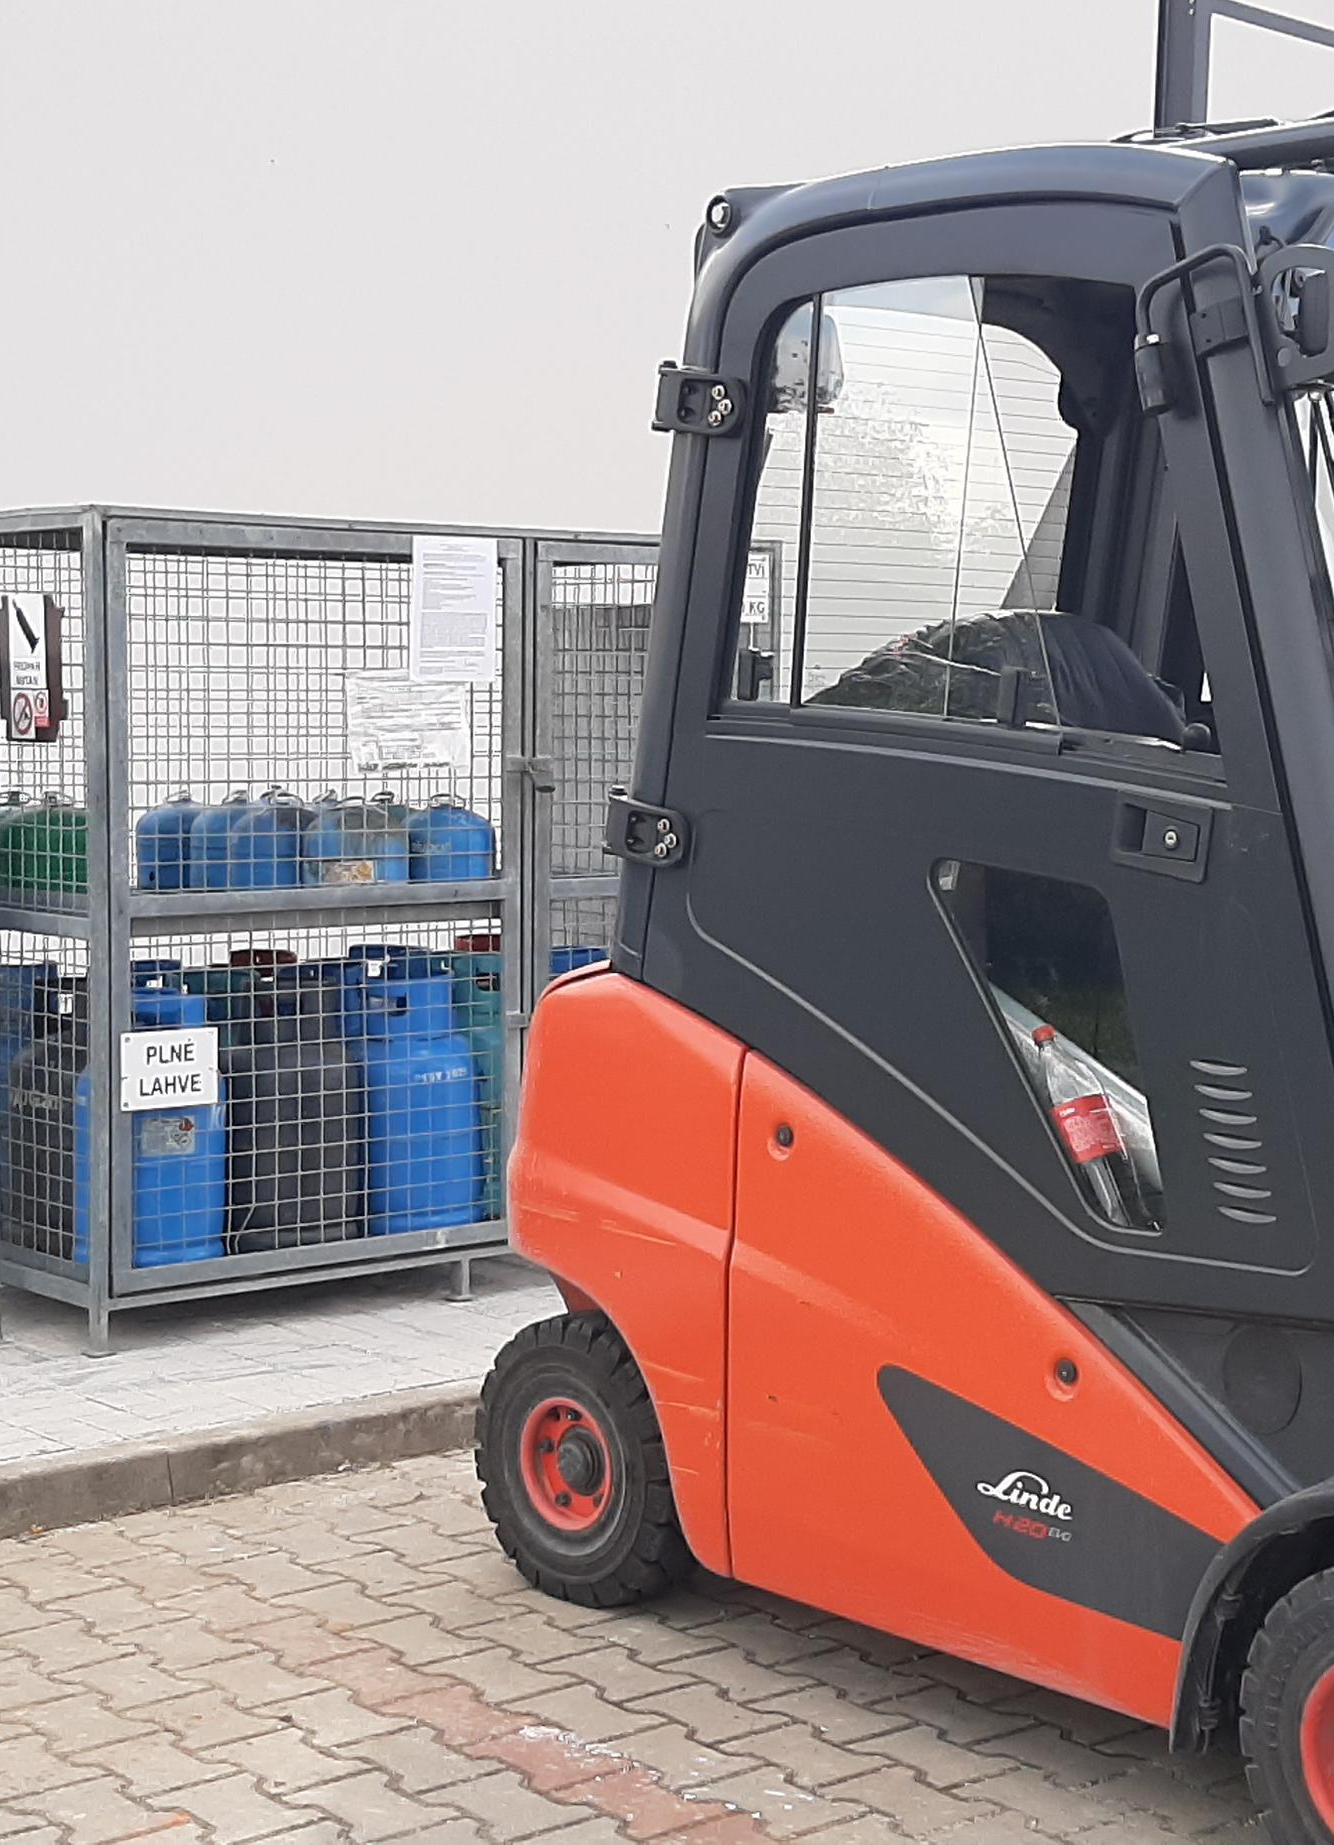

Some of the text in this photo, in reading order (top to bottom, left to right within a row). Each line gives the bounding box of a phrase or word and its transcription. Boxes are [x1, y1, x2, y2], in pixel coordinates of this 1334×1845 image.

[749, 601, 765, 614] KG
[146, 1038, 195, 1066] PLNÉ
[139, 1073, 202, 1097] LAHVE
[977, 1471, 1073, 1520] Linde
